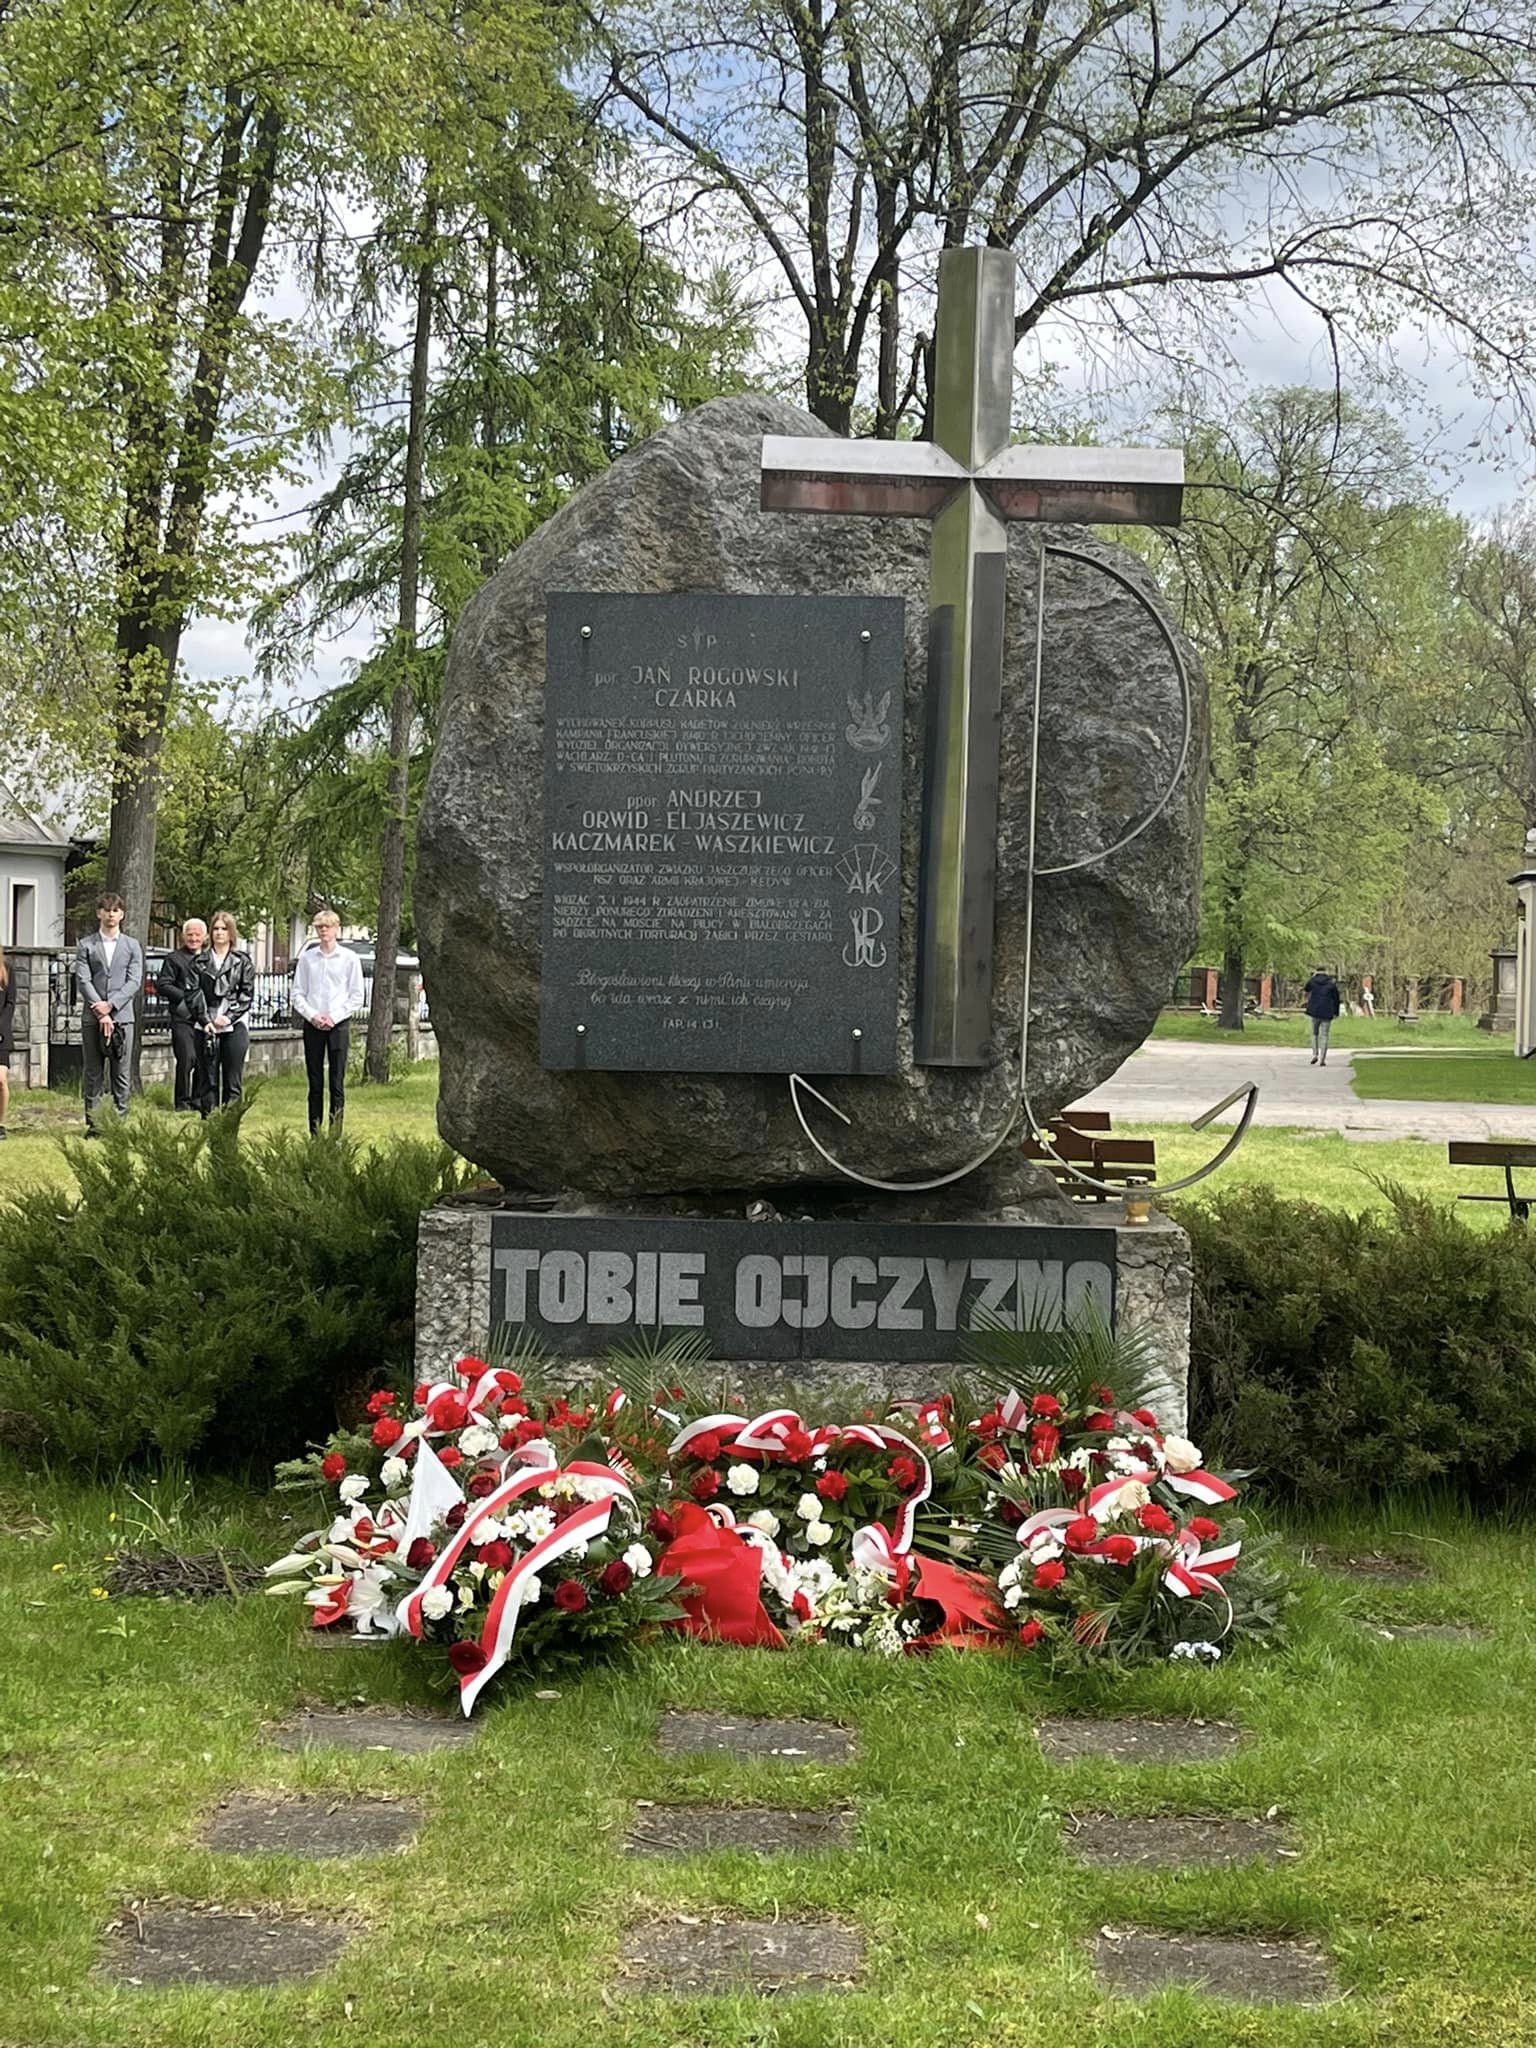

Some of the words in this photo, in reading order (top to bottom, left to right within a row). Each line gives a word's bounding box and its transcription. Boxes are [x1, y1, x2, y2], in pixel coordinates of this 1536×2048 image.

[630, 665, 672, 685] JAN
[689, 666, 799, 688] ROGOWSKI
[655, 688, 737, 708] CZARKA
[667, 789, 762, 809] ANDRZEJ
[582, 810, 648, 829] ORWID
[667, 811, 806, 832] ELJASZEWICZ
[552, 832, 676, 852] KACZMAREK
[695, 834, 836, 855] WASZKIEWICZ
[618, 875, 646, 886] ORAZ
[848, 871, 883, 895] AK
[623, 895, 646, 906] 1944
[602, 918, 616, 928] NA
[671, 919, 684, 929] NA
[785, 932, 833, 943] GESTAPO
[494, 1249, 706, 1326] TOBIE
[735, 1254, 1112, 1333] OJCZYZNO
